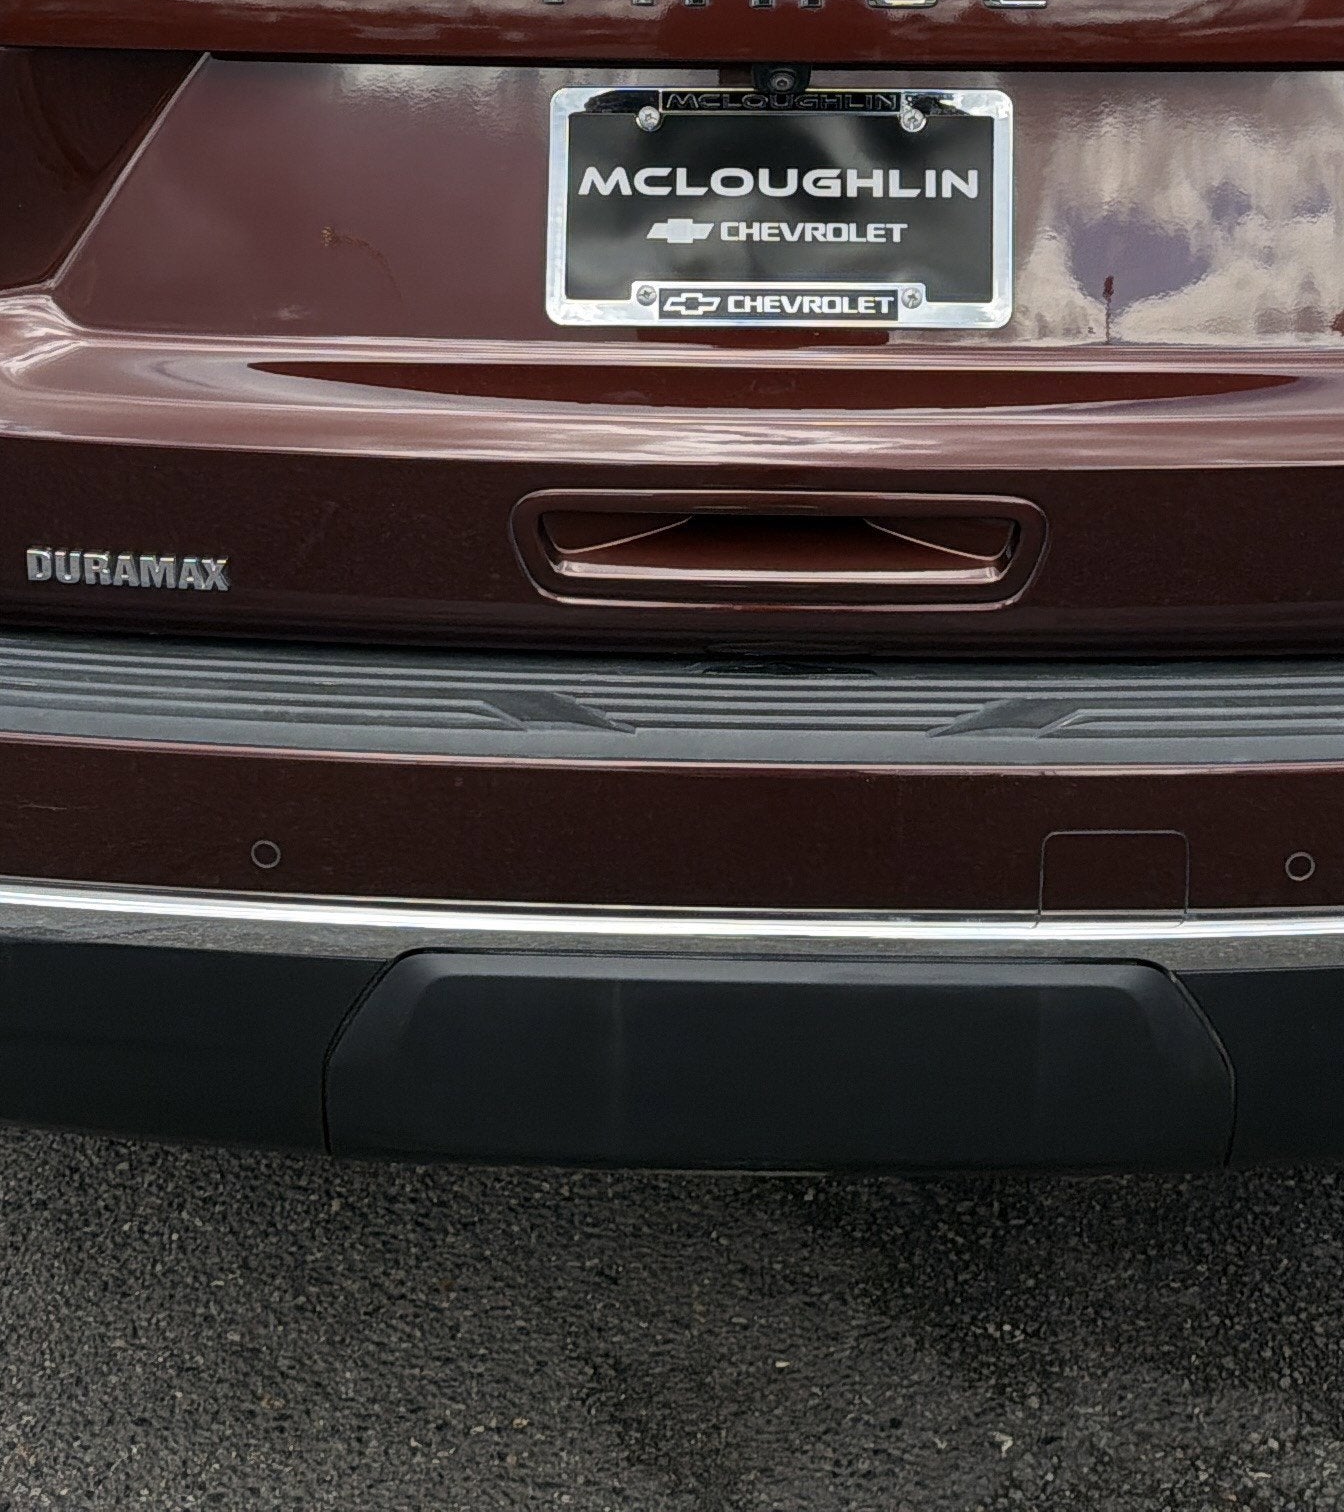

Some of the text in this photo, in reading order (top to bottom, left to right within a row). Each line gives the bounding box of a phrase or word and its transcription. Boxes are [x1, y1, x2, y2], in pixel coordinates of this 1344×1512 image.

[665, 92, 898, 110] MCLOUGHLIN
[578, 166, 979, 199] MCLOUGHLIN
[720, 221, 908, 243] CHEVROLET
[727, 294, 895, 315] CHEVROLET
[26, 547, 230, 591] DURAMAX
